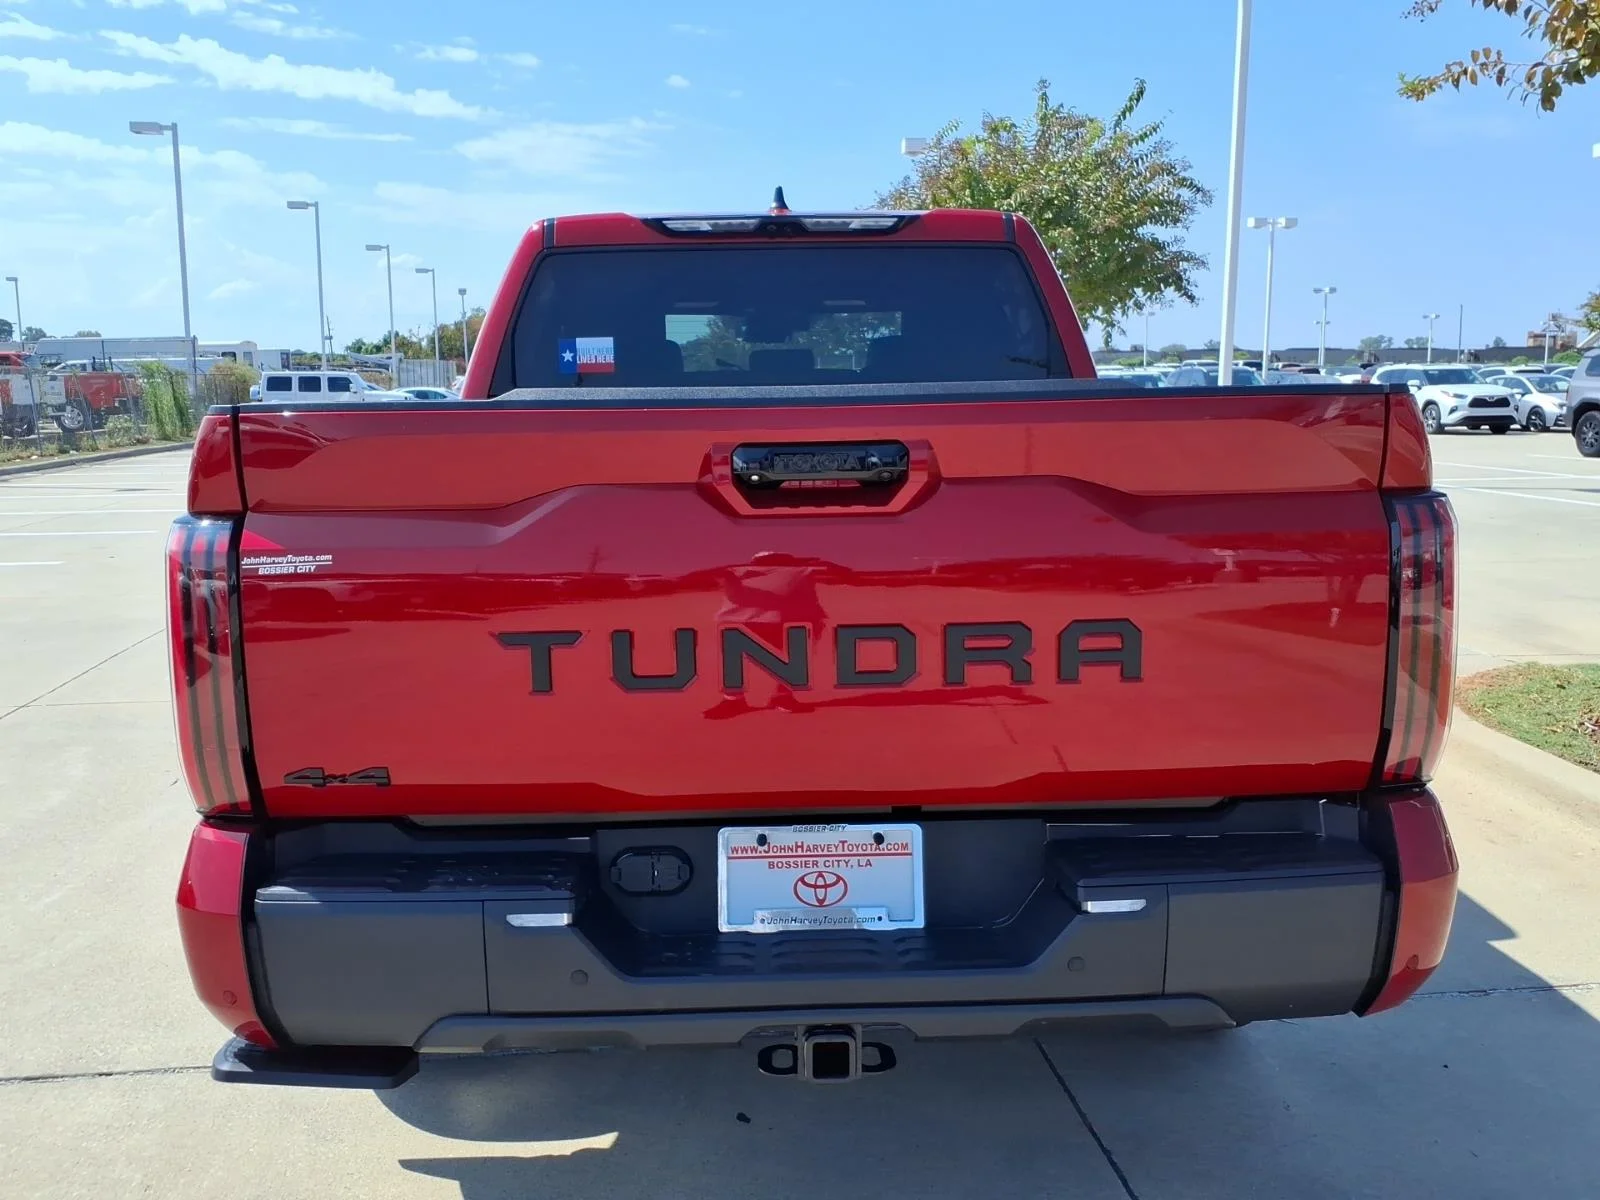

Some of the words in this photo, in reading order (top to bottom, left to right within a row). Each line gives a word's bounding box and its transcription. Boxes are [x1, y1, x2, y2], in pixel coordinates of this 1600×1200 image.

[576, 354, 596, 364] LIVES
[596, 354, 615, 364] HERE
[778, 453, 862, 473] TOYOTA
[241, 555, 333, 565] JohnHarveyToyota.com
[258, 566, 295, 575] BOSSIER
[296, 565, 316, 573] CITY
[490, 618, 1144, 695] TUNDRA
[792, 824, 827, 833] BOSSIER
[828, 823, 848, 832] CITY
[767, 859, 819, 870] BOSSIER
[823, 859, 854, 869] CITY,
[857, 858, 873, 868] LA
[766, 914, 876, 927] JohnHarveyToyota.com
